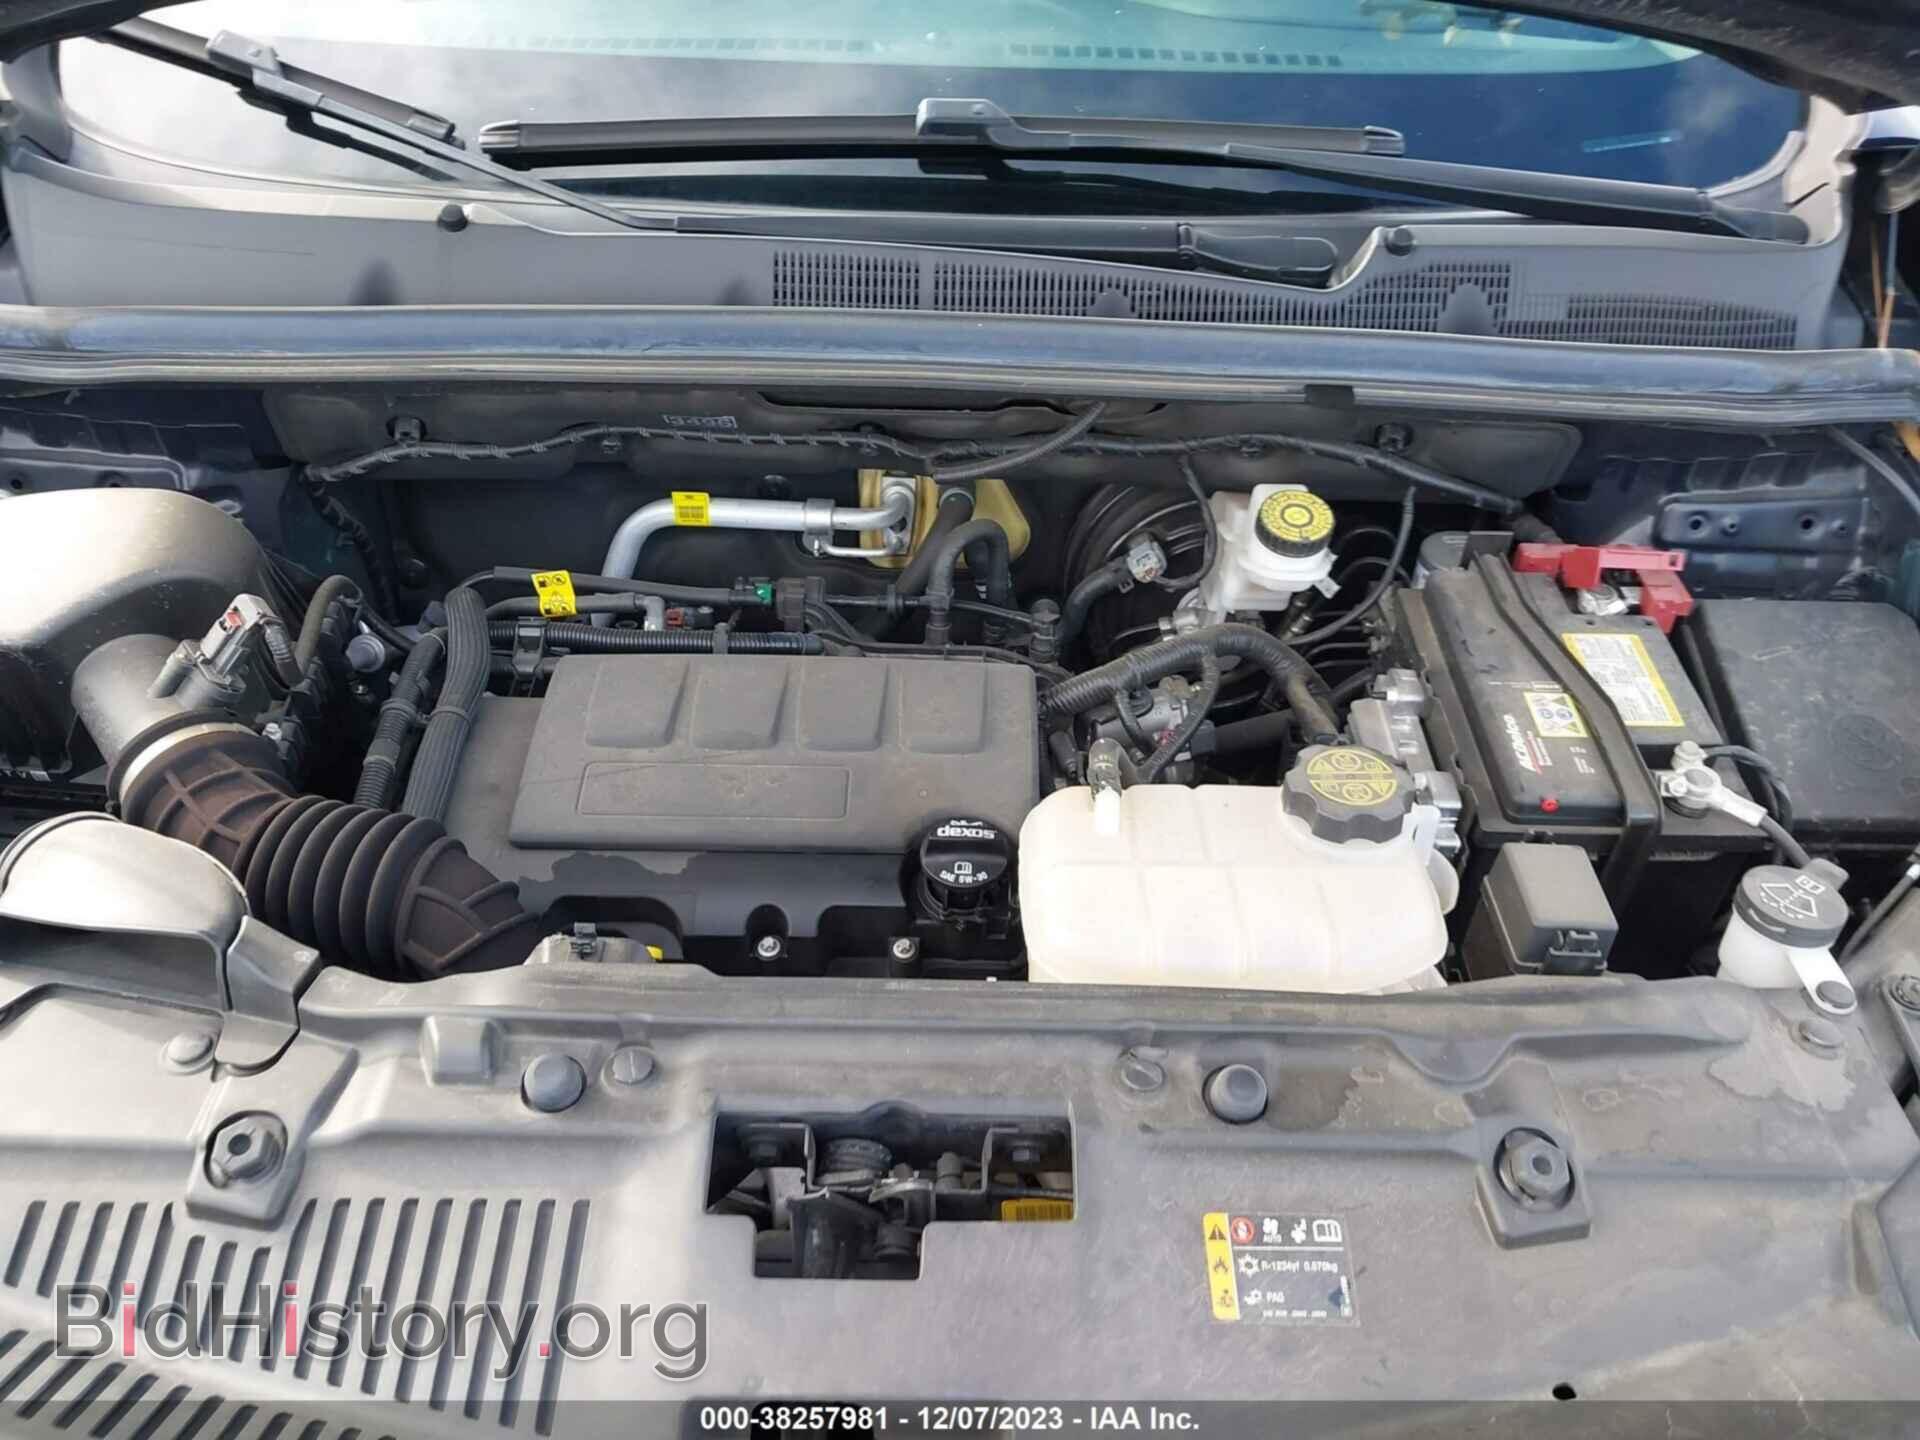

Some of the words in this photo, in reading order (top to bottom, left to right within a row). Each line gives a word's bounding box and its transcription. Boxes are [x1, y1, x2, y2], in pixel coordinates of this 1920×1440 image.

[1503, 714, 1537, 773] ACDelco
[937, 825, 997, 839] dexos
[1265, 1291, 1285, 1303] PAG
